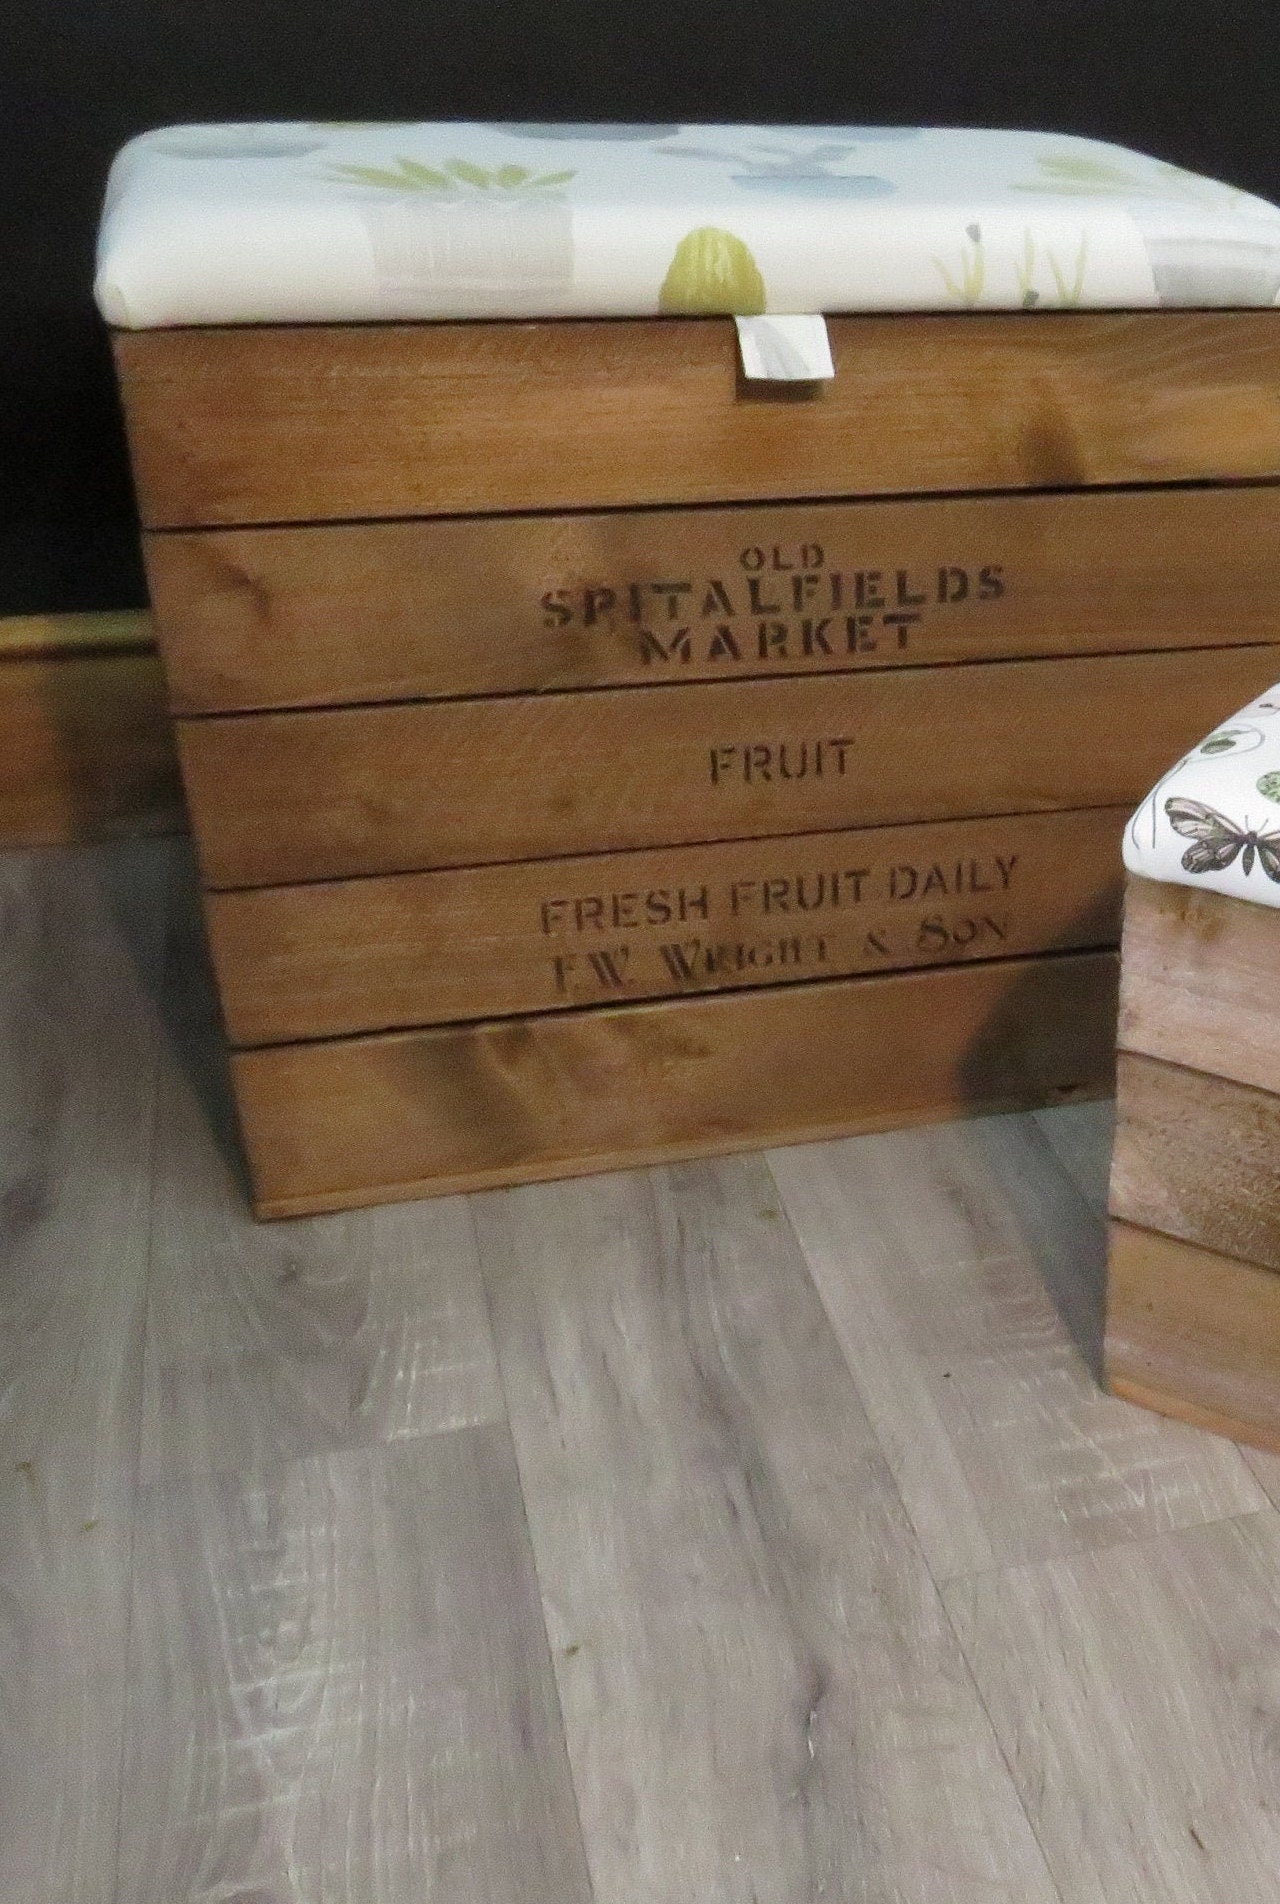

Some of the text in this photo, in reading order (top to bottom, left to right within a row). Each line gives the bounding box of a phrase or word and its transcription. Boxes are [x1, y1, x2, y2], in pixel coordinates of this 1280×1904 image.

[738, 544, 826, 571] OLD
[540, 565, 1006, 629] SPITALFIELDS
[641, 613, 922, 666] MARKET
[709, 738, 856, 785] FRUIT
[540, 852, 1019, 936] FRESH FRUIT DAILY
